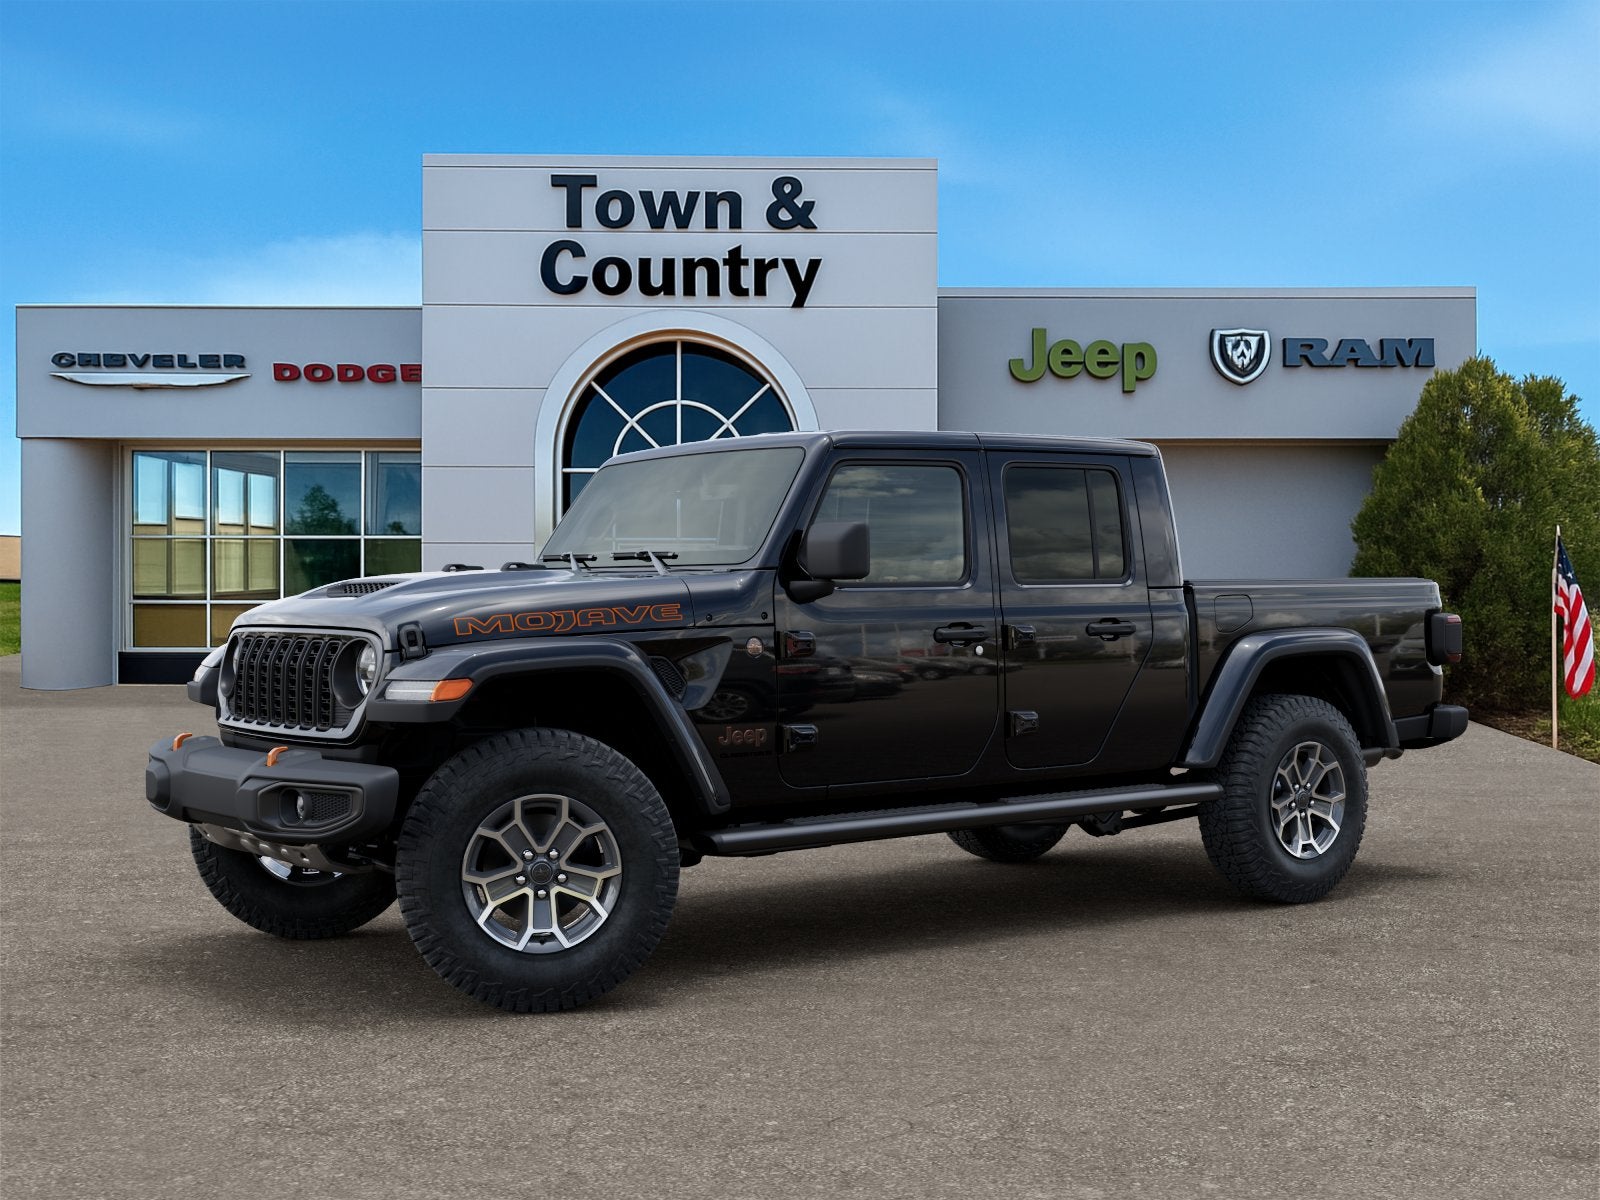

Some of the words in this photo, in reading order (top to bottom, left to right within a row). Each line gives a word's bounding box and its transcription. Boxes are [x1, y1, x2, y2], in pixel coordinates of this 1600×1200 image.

[552, 174, 742, 229] Town
[765, 176, 818, 229] &
[540, 239, 822, 308] Country
[1009, 328, 1156, 392] Jeep
[1283, 337, 1436, 367] RAM
[273, 362, 421, 383] DODGE
[454, 603, 683, 635] MOJAVE
[718, 726, 768, 746] Jeep
